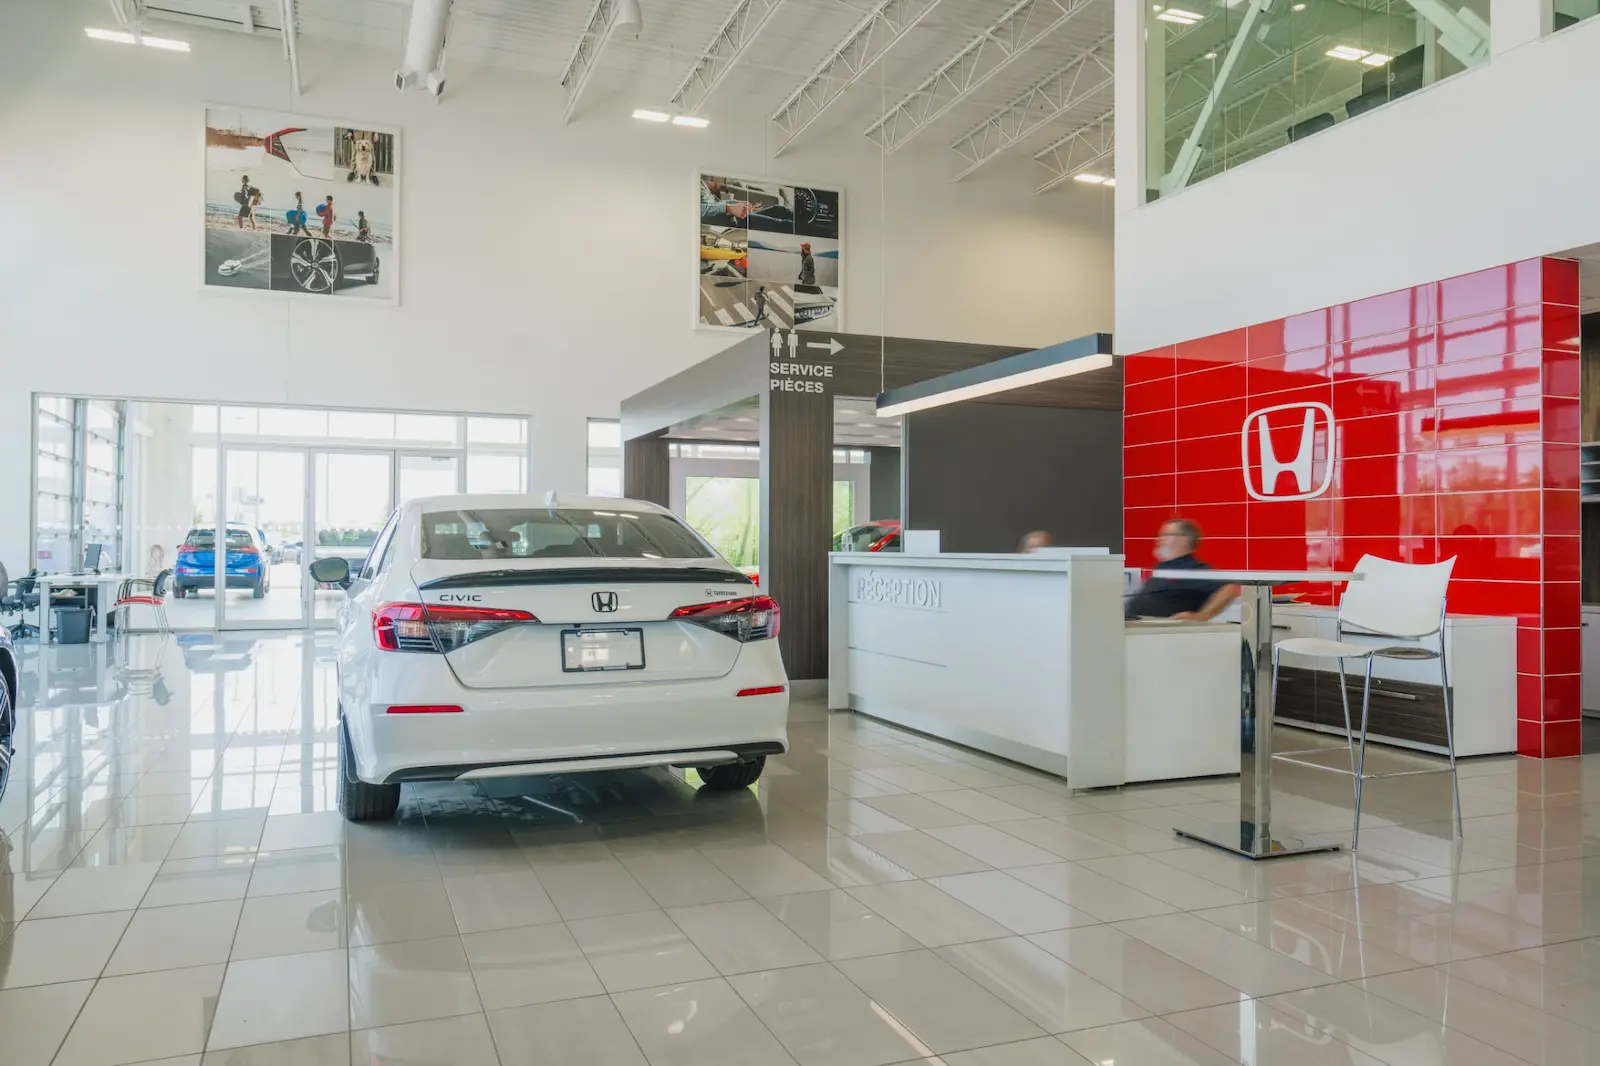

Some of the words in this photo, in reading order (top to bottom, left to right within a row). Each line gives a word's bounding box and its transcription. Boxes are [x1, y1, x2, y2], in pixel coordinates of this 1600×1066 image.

[770, 362, 833, 377] SERVICE
[770, 378, 824, 393] PIÈCES
[857, 569, 943, 607] RÉCEPTION
[439, 594, 482, 602] CIVIC
